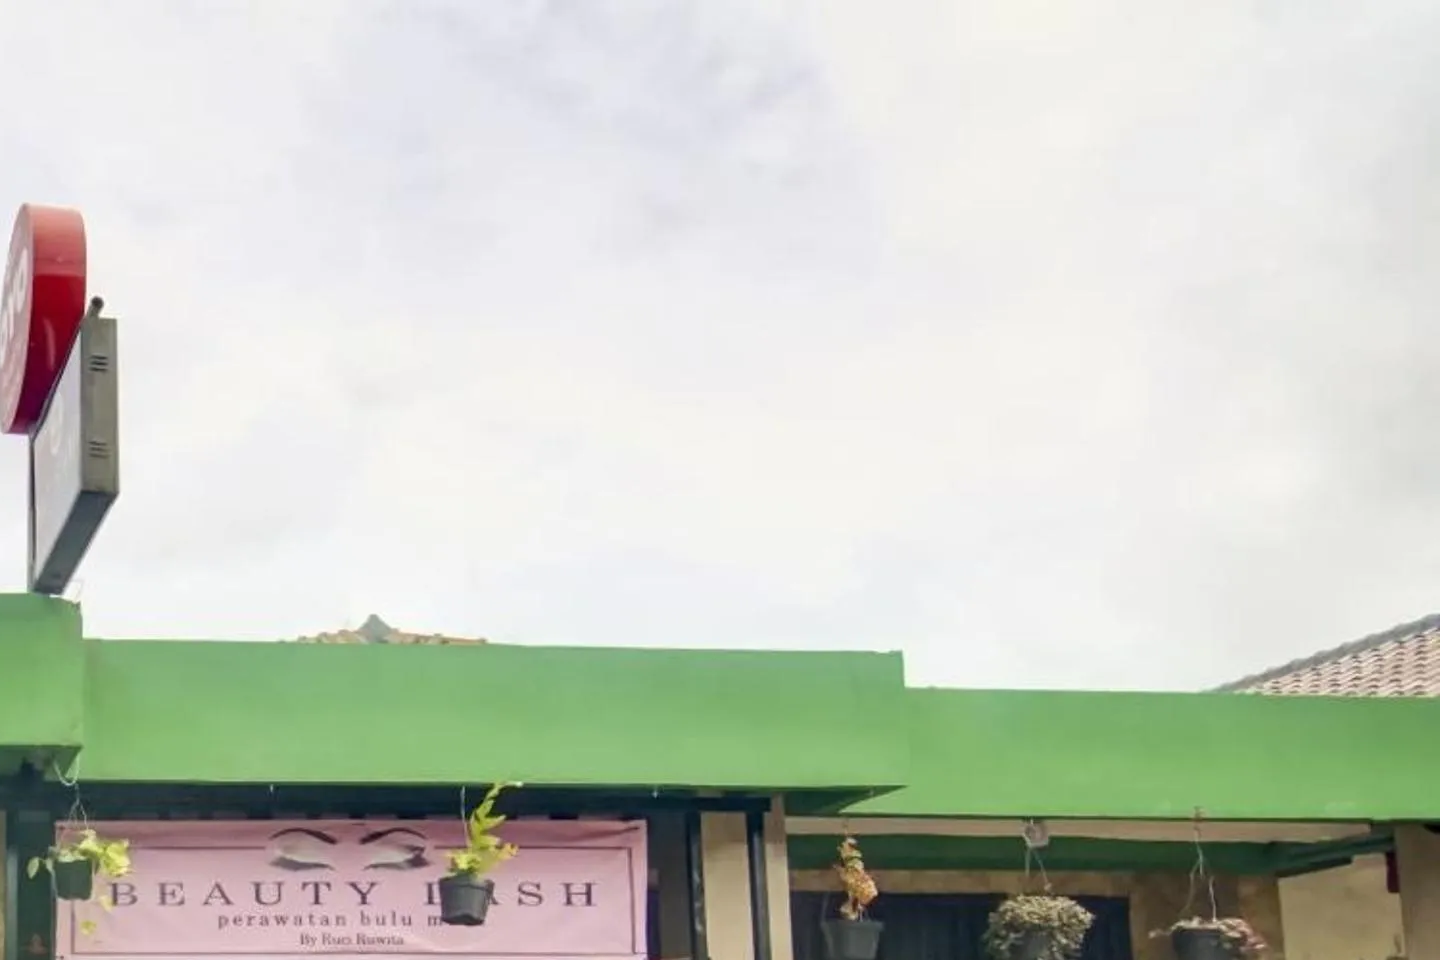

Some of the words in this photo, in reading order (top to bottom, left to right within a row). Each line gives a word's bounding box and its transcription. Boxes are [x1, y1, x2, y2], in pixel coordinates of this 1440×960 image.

[109, 880, 382, 906] BEAUTY
[216, 912, 348, 929] perawatan
[360, 910, 414, 927] bulu
